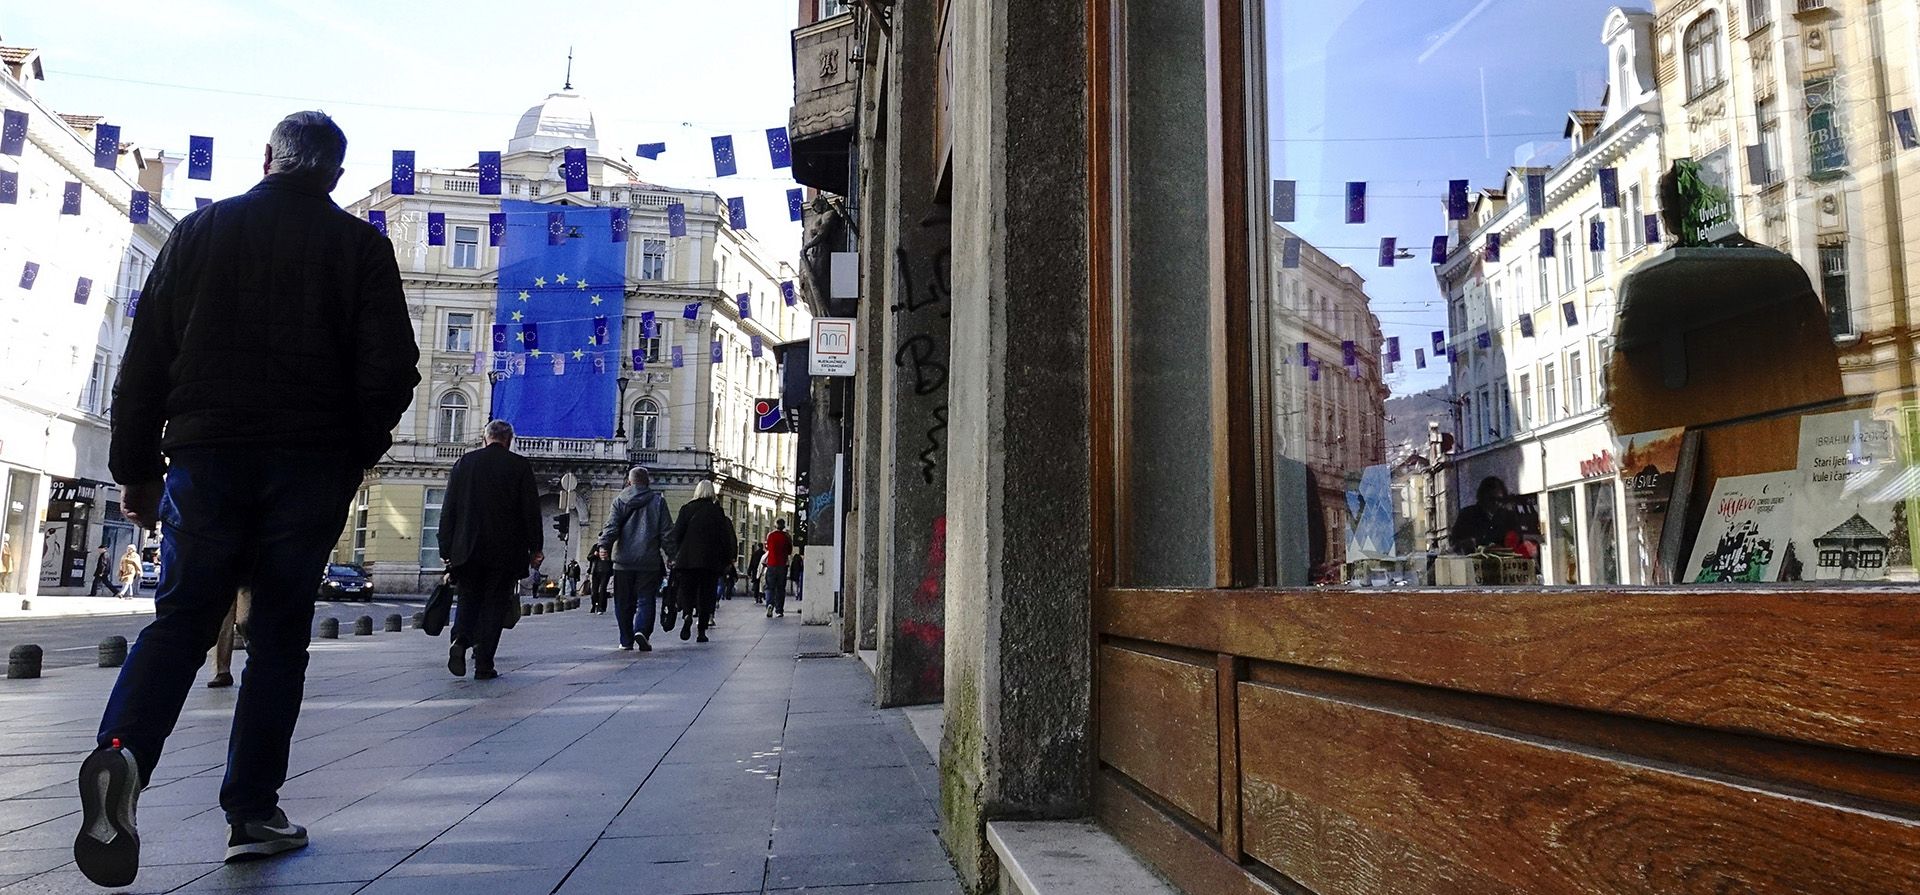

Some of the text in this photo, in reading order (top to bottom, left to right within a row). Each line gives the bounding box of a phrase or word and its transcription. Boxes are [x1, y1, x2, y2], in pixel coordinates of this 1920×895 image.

[1699, 201, 1727, 223] Uvod u
[1815, 434, 1850, 447] IBRAHIM
[1813, 455, 1832, 468] Stari
[1812, 471, 1829, 482] kule
